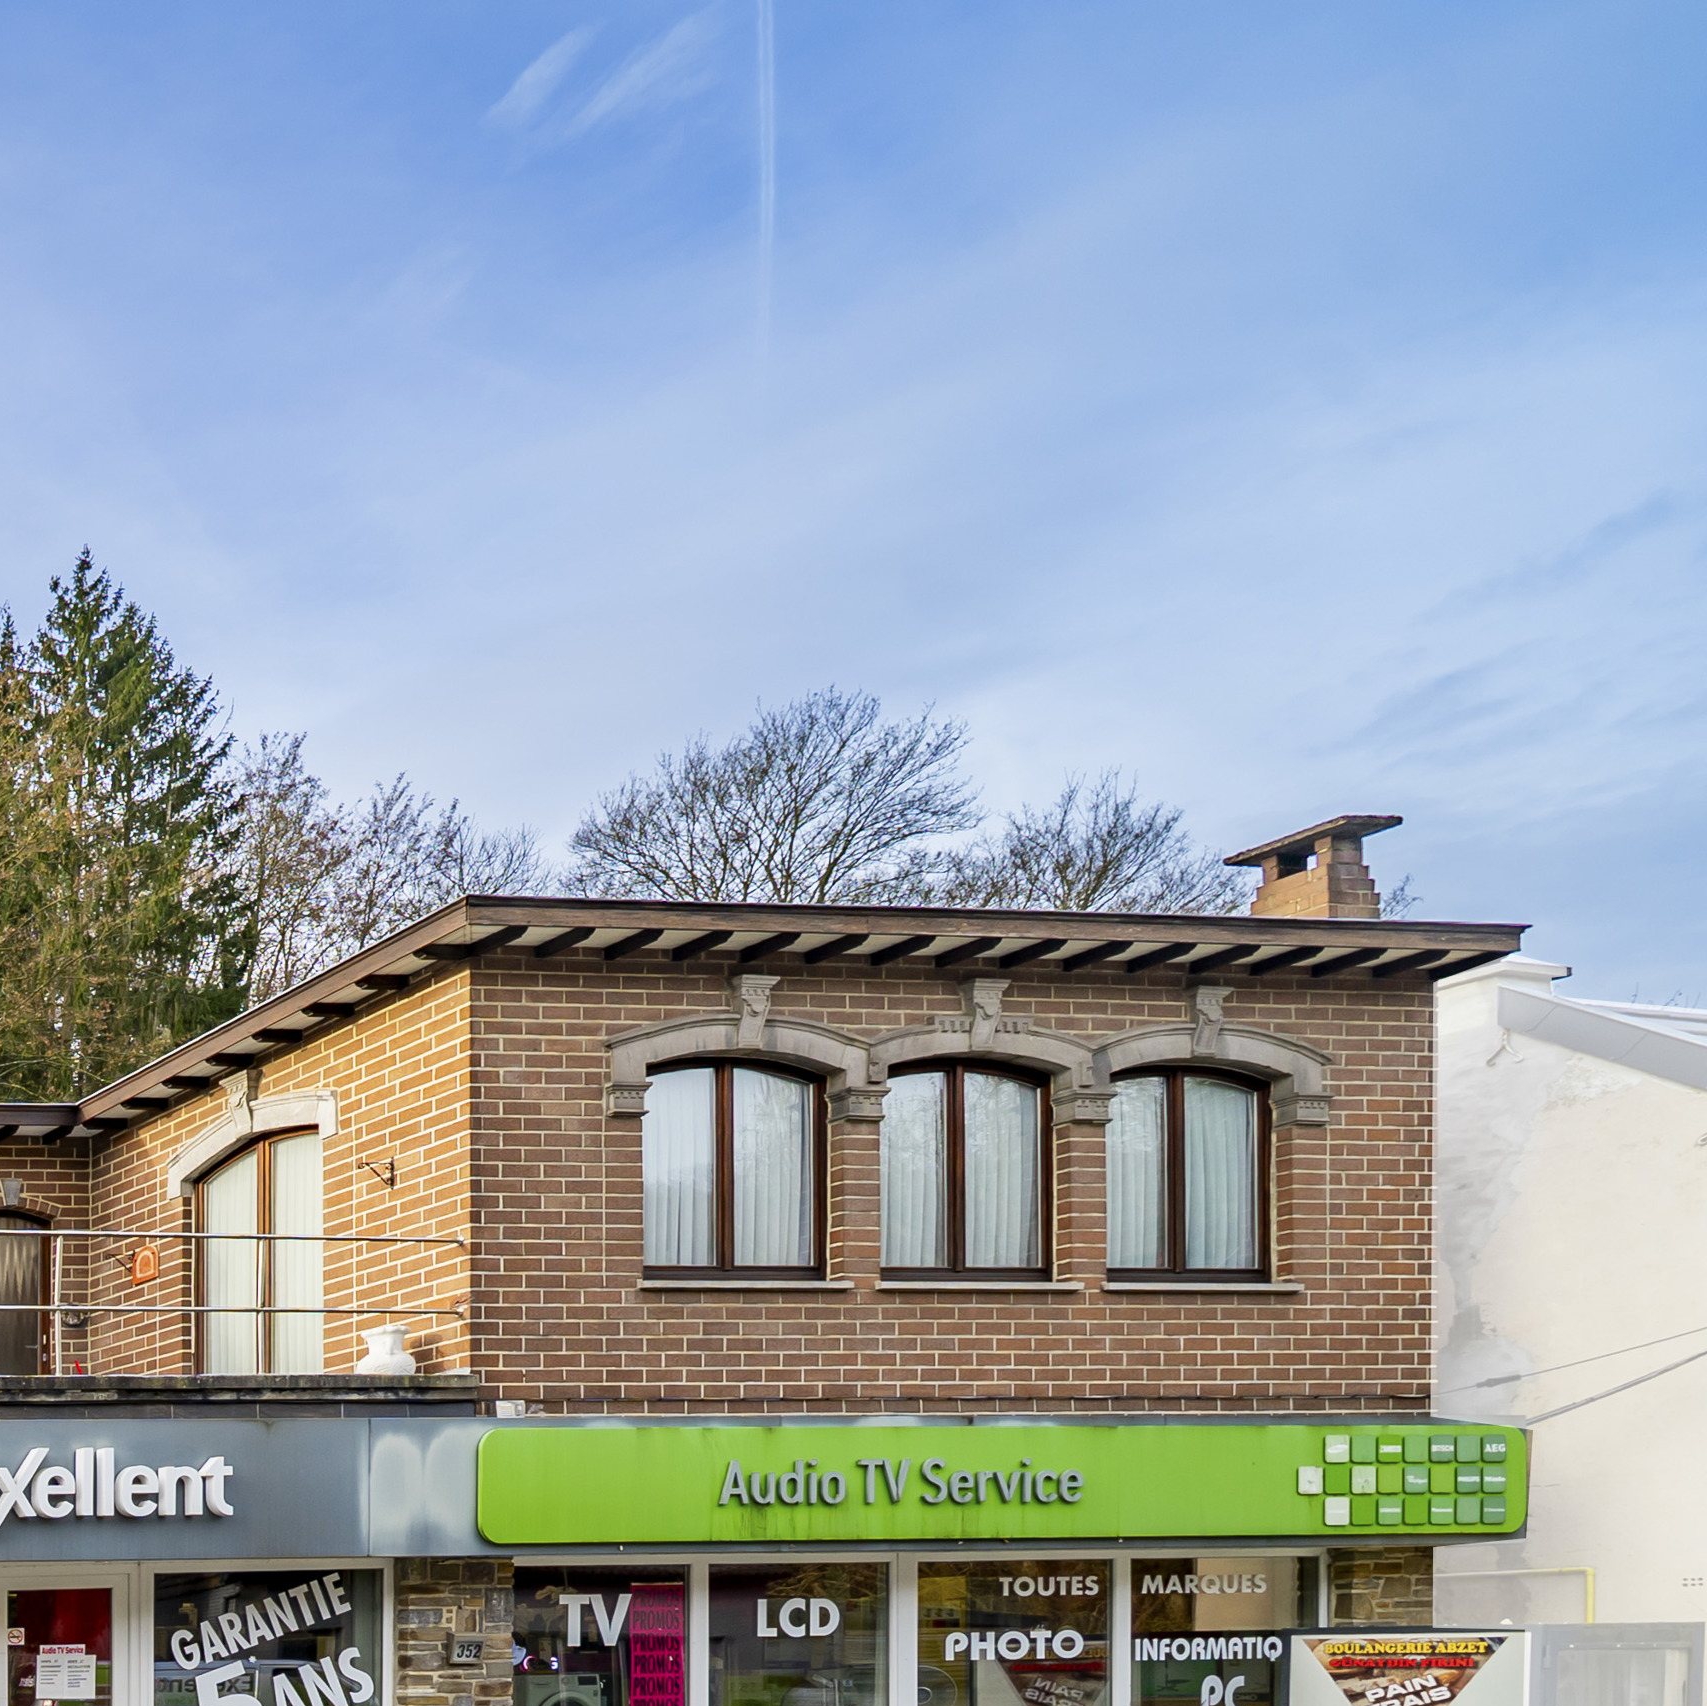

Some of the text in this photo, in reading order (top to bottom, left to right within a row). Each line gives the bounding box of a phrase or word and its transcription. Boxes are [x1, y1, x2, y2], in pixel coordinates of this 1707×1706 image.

[1484, 1443, 1506, 1453] AEG
[718, 1457, 1085, 1506] Audio TV Service
[999, 1573, 1267, 1597] TOUTES MARQUES
[171, 1572, 352, 1671] GARANTIE
[558, 1593, 633, 1647] TV
[632, 1610, 680, 1630] PROMOS
[756, 1597, 841, 1638] LCD
[42, 1645, 84, 1654] Audio TV Service
[456, 1644, 482, 1659] 352
[632, 1632, 680, 1652] PROMOS
[944, 1629, 1085, 1662] PHOTO
[1324, 1641, 1489, 1655] BOULANGERIE ABZET
[632, 1653, 680, 1674] PROMOS
[632, 1676, 680, 1696] PROMOS
[1364, 1673, 1437, 1703] PAIN
